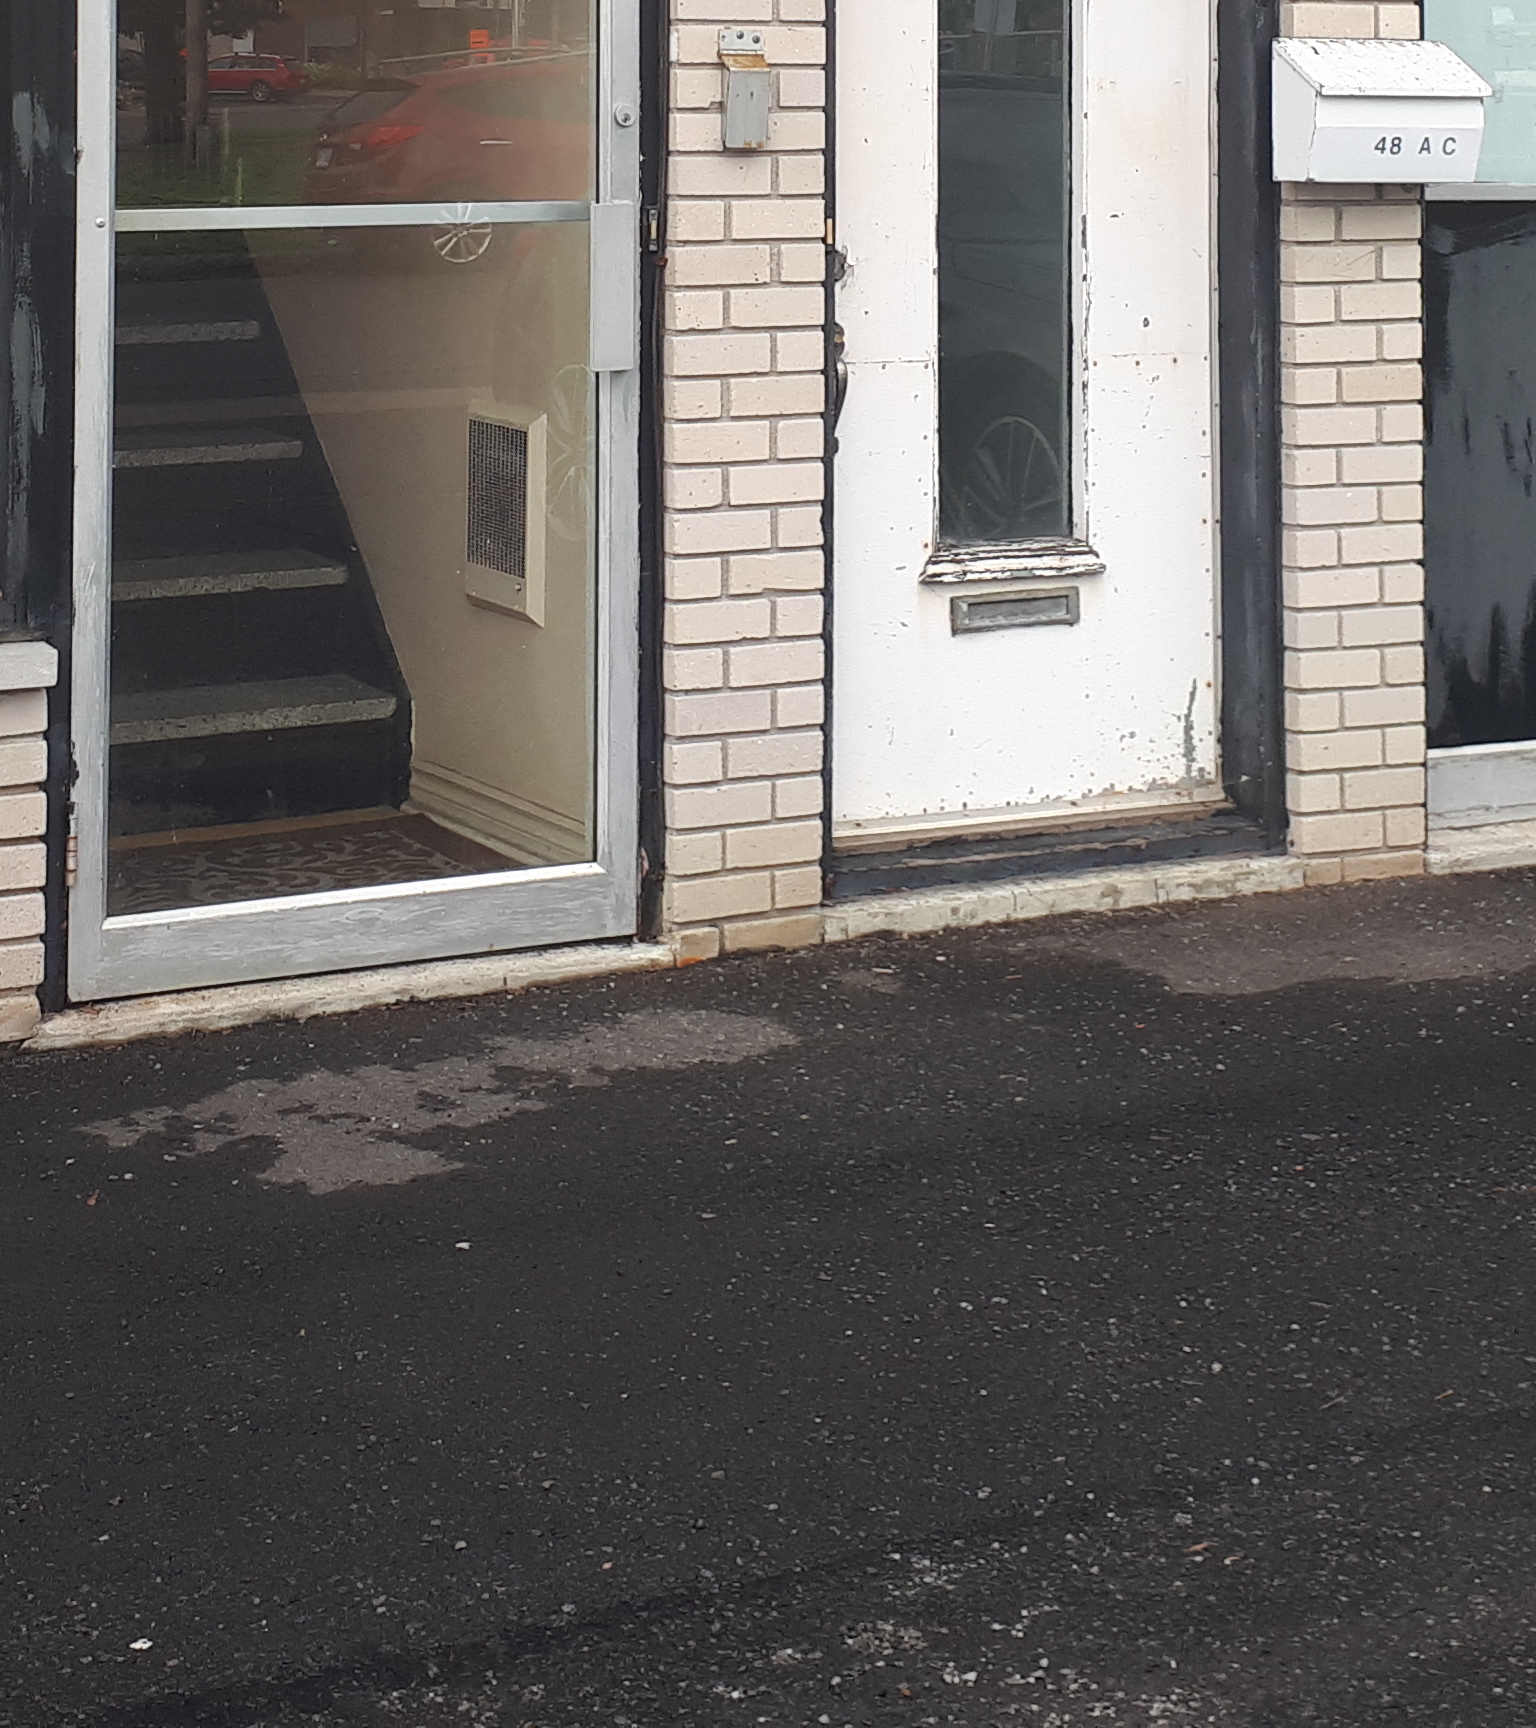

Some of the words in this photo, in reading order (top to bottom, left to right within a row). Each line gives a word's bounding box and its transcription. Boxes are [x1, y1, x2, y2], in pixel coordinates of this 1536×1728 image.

[1374, 136, 1402, 155] 48
[1418, 136, 1432, 155] A
[1442, 137, 1457, 155] C
